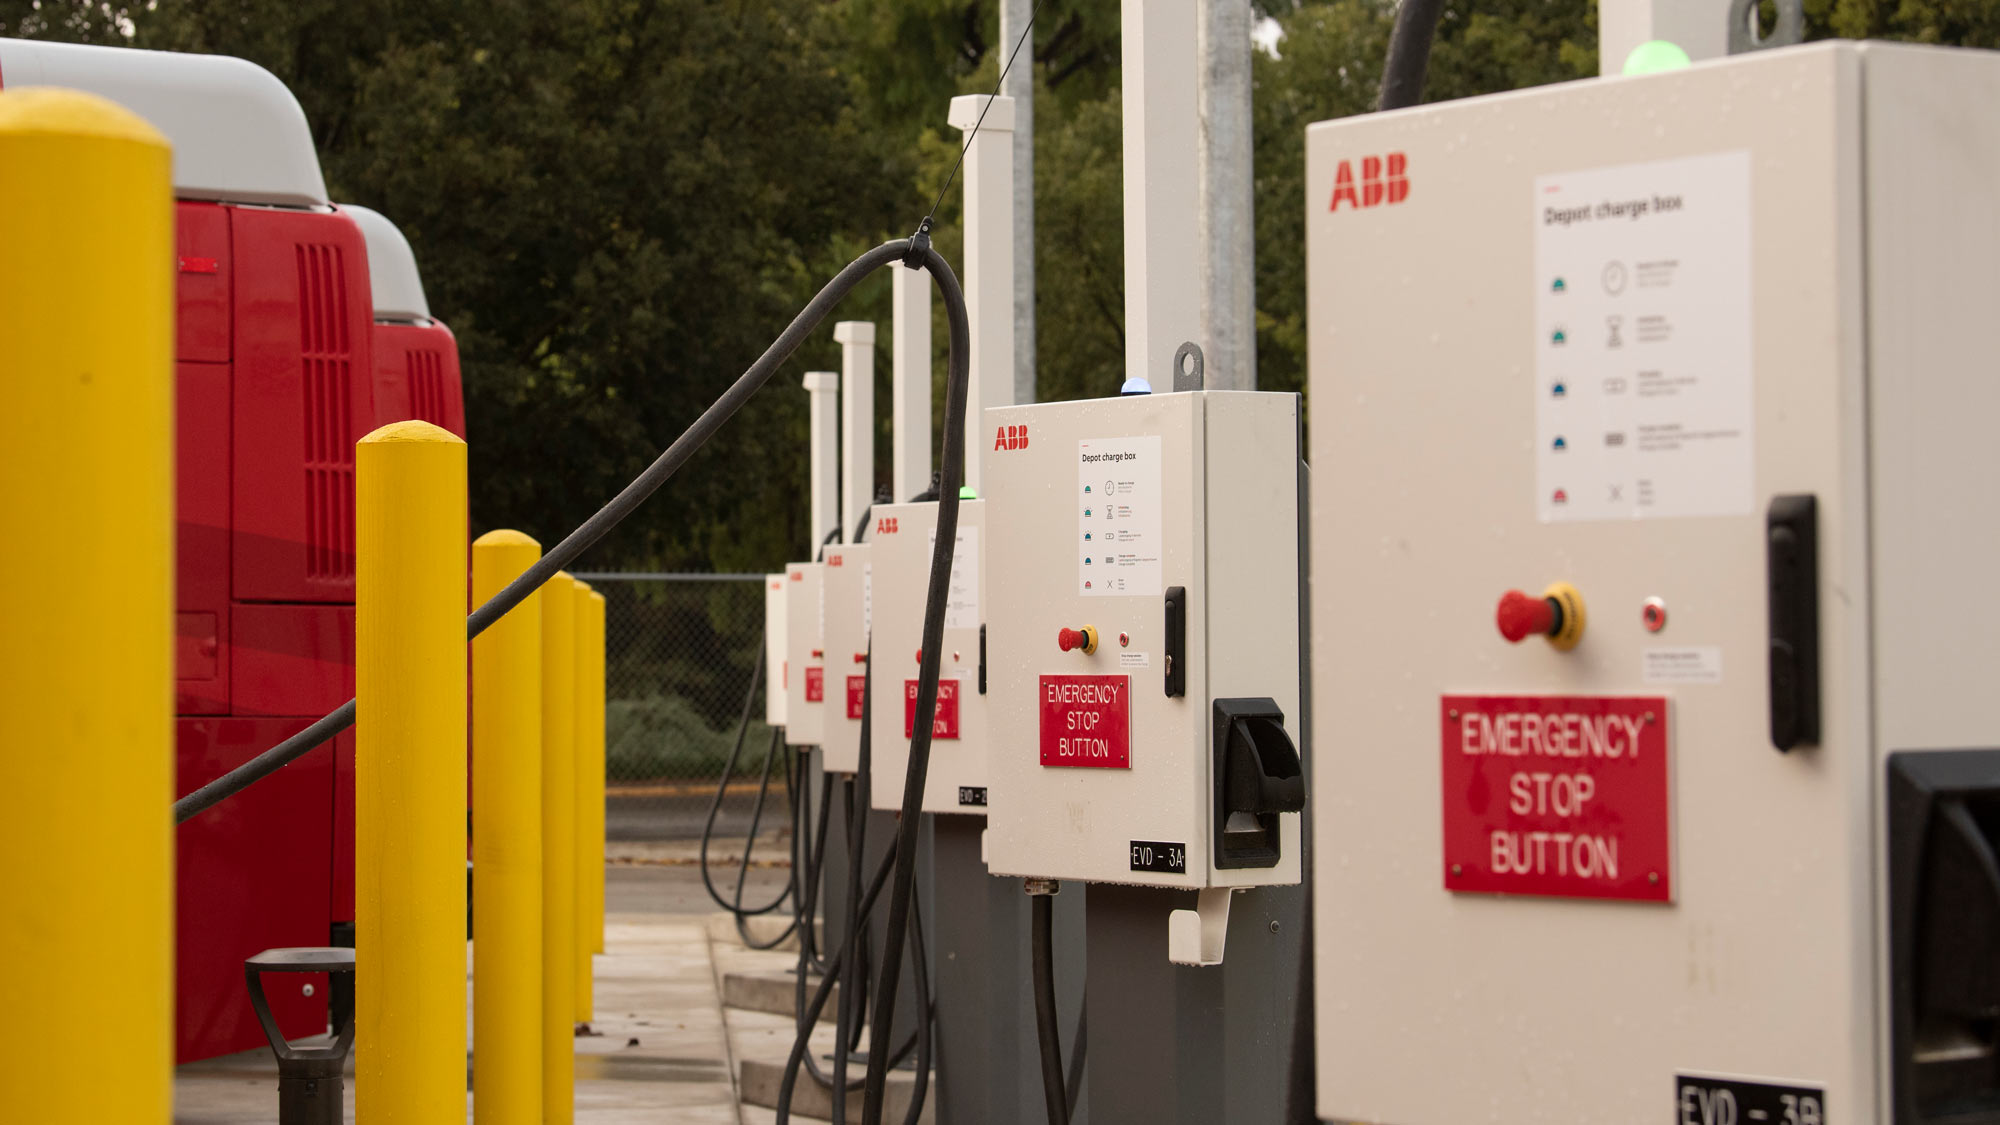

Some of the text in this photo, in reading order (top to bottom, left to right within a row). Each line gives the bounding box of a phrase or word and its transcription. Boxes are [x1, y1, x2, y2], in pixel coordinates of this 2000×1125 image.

[1330, 152, 1410, 213] ABB
[1544, 193, 1682, 227] Depot charge box
[994, 425, 1029, 451] ABB
[1082, 451, 1136, 463] Depot charge box
[877, 518, 898, 534] ABB
[1048, 684, 1119, 704] EMERGENCY
[1067, 711, 1100, 730] STOP
[1059, 738, 1108, 758] BUTTON
[1462, 712, 1646, 758] EMERGENCY
[1509, 773, 1595, 817] STOP
[1133, 847, 1153, 866] EVD
[1169, 848, 1183, 867] 3A
[1490, 831, 1618, 879] BUTTON
[1681, 1085, 1738, 1125] EVD
